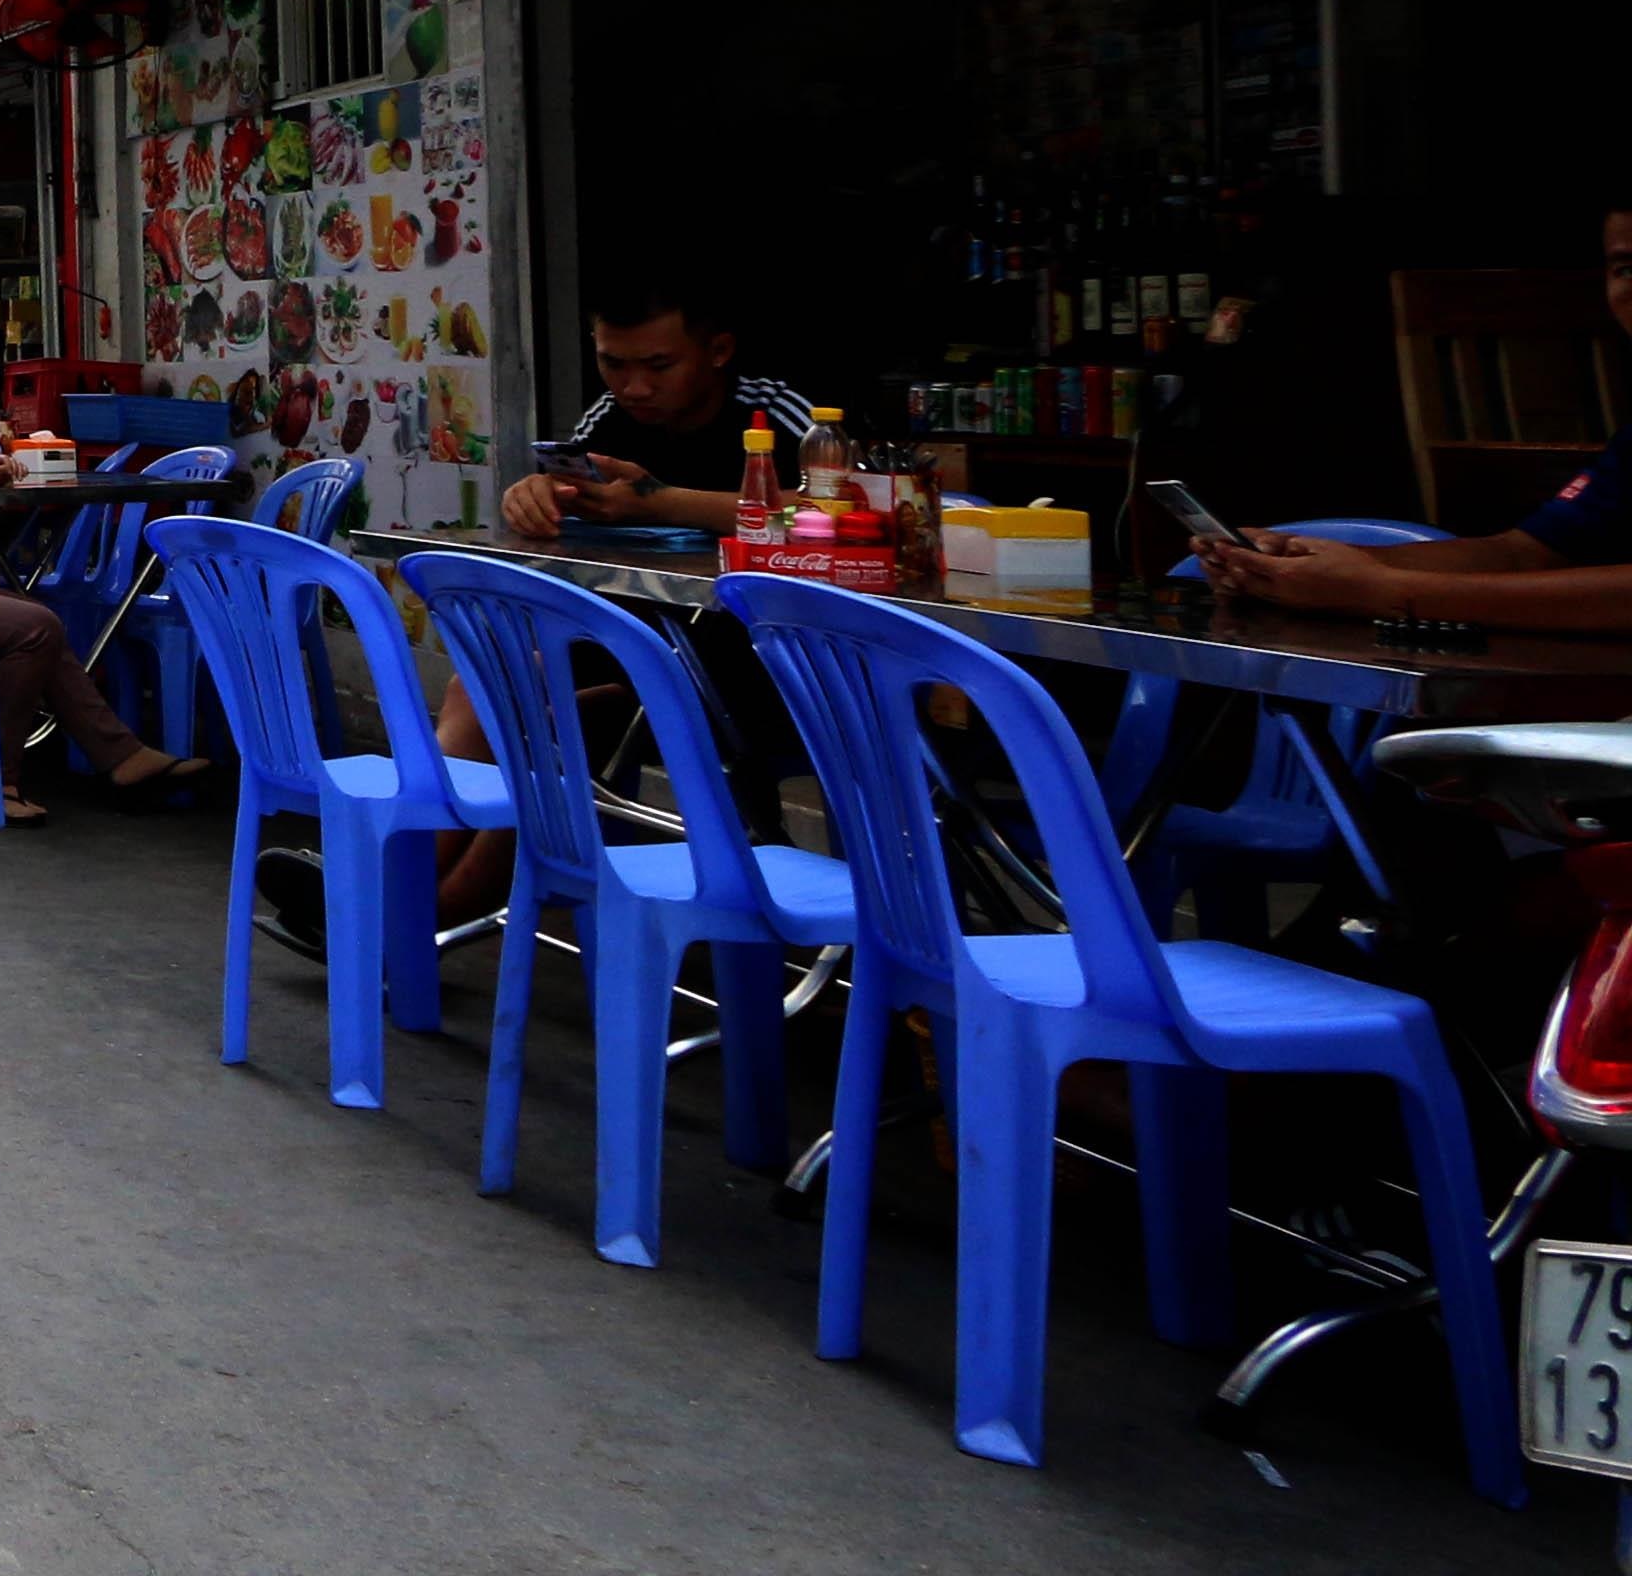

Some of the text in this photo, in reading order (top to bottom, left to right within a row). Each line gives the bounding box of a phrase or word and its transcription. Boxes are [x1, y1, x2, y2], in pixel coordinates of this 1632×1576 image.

[767, 550, 833, 572] Coca-Cola
[1567, 1260, 1632, 1352] 79
[1544, 1354, 1620, 1452] 13
